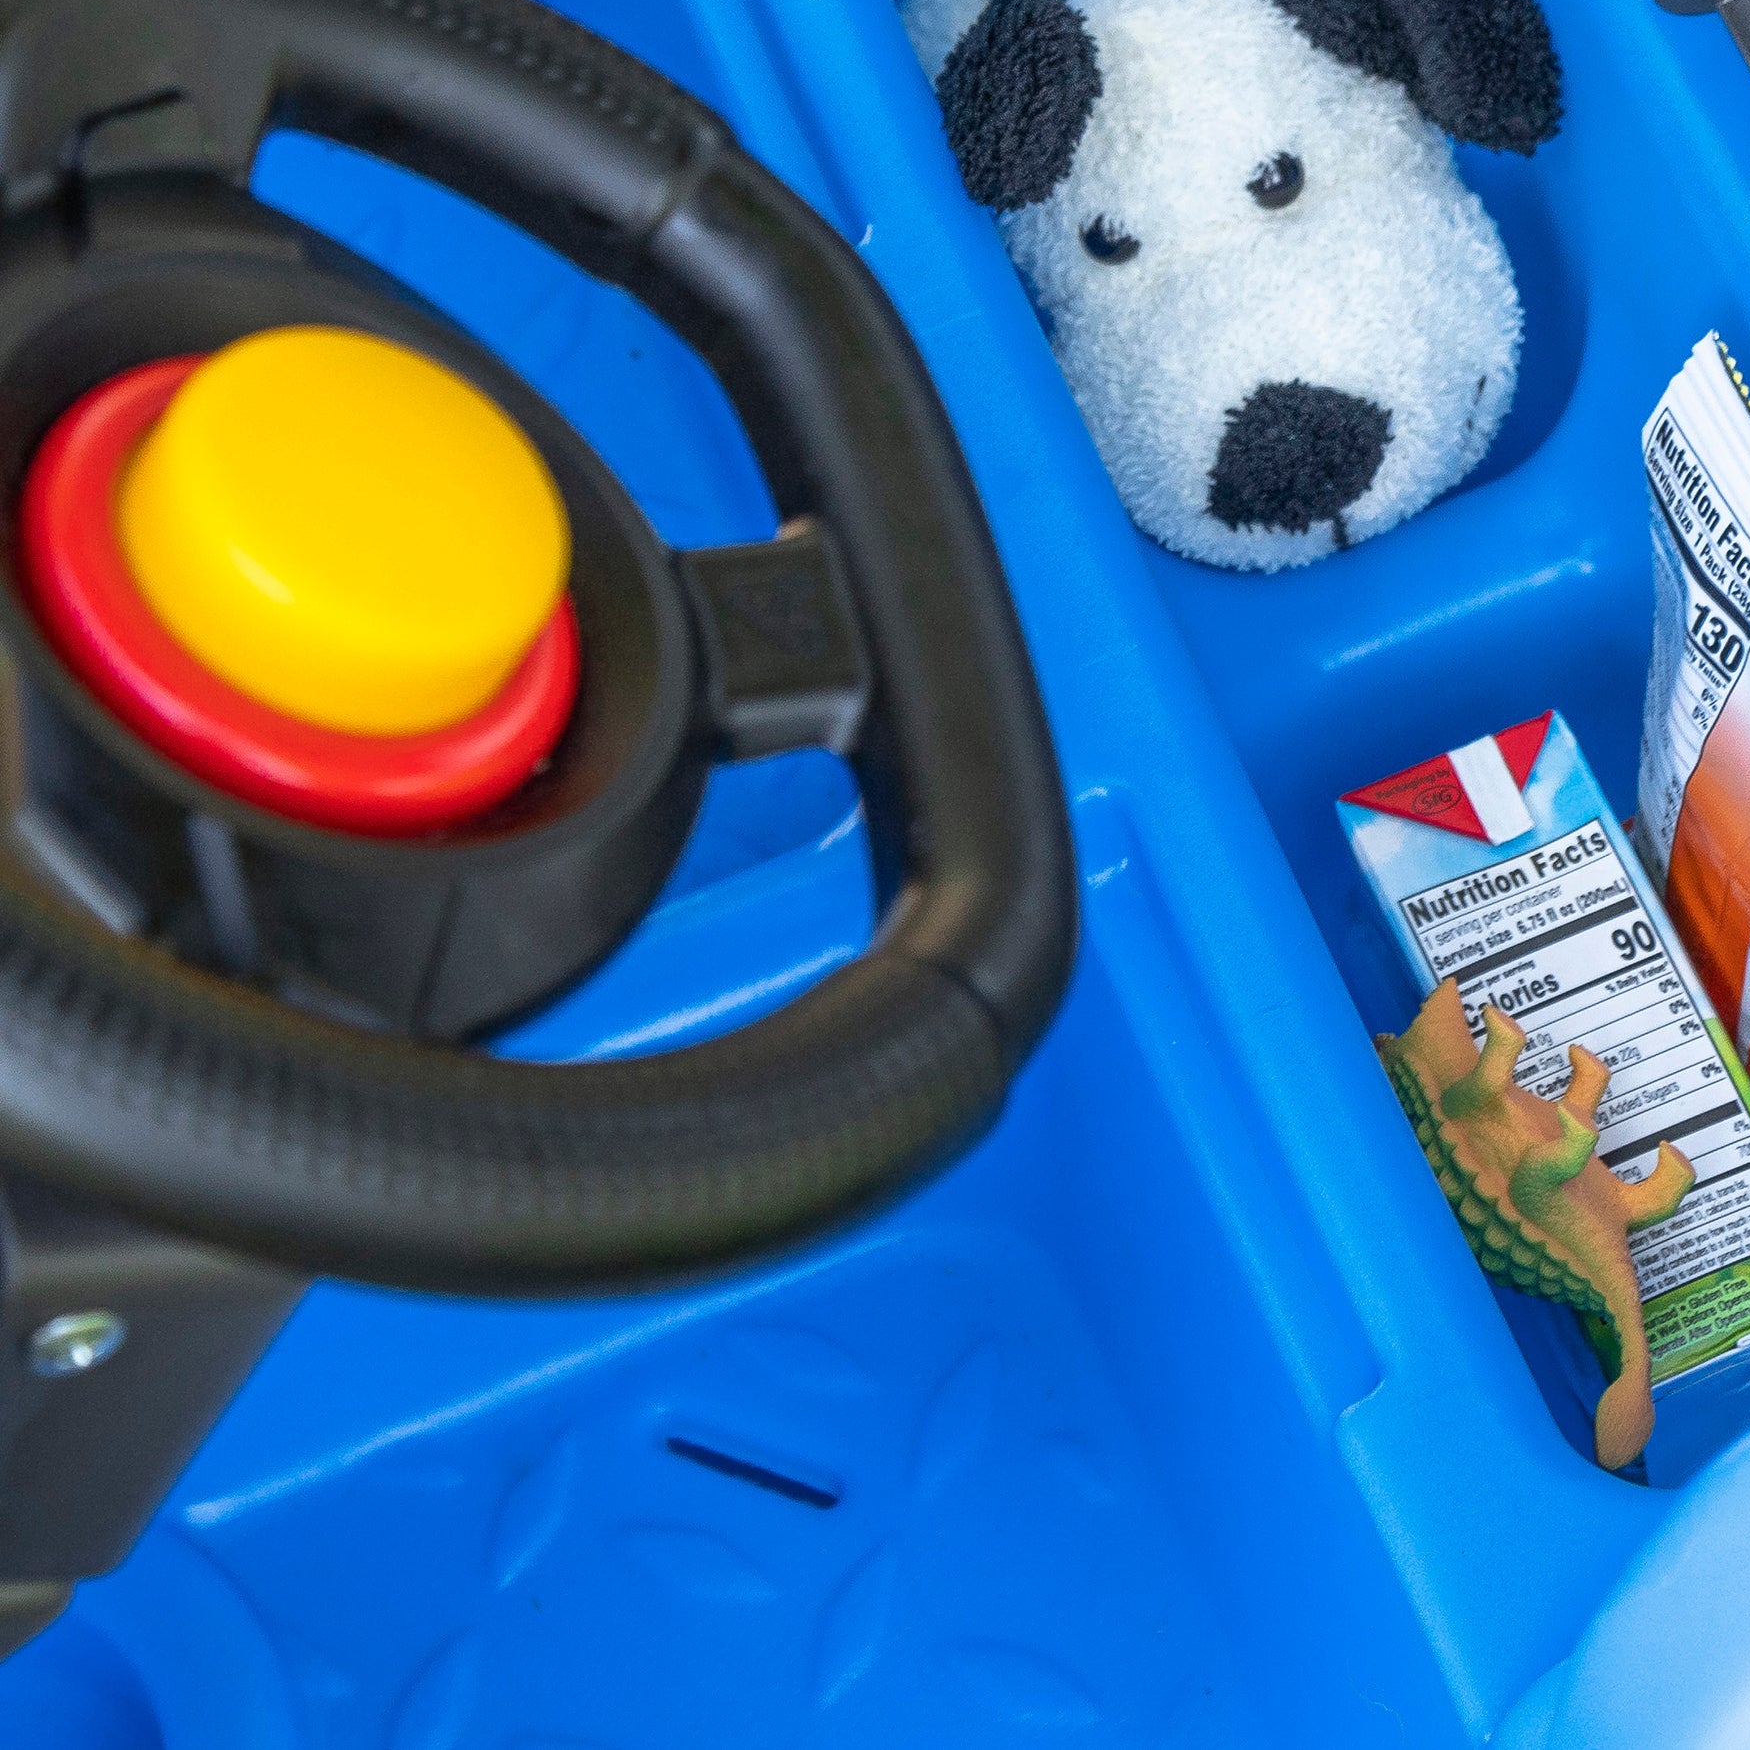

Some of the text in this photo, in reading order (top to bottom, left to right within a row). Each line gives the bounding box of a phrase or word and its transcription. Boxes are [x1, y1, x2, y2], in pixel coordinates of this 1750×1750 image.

[1656, 419, 1720, 532] Nutrition
[1648, 447, 1676, 507] Serving
[1674, 499, 1693, 534] Size
[1694, 532, 1703, 547] 1
[1699, 543, 1727, 584] Pack
[1692, 603, 1745, 673] 130
[1406, 832, 1608, 929] Nutrition Facts
[1423, 885, 1562, 951] 1 serving per container
[1431, 877, 1631, 972] Serving size 6.75 fl oz (200mL)
[1611, 920, 1657, 961] 90
[1484, 973, 1501, 988] per
[1501, 959, 1536, 979] serving
[1615, 975, 1640, 990] Daily
[1658, 977, 1681, 994] 0%
[1668, 998, 1691, 1015] 0%
[1535, 1032, 1554, 1049] 0g
[1679, 1019, 1701, 1036] 8%
[1538, 1053, 1566, 1071] 5mg
[1617, 1046, 1642, 1063] 22g
[1700, 1062, 1723, 1079] 0%
[1607, 1096, 1643, 1119] Added
[1640, 1081, 1680, 1104] Sugars
[1687, 1289, 1723, 1310] Gluten
[1722, 1278, 1749, 1295] Free
[1680, 1306, 1718, 1329] Before
[1688, 1323, 1713, 1342] After
